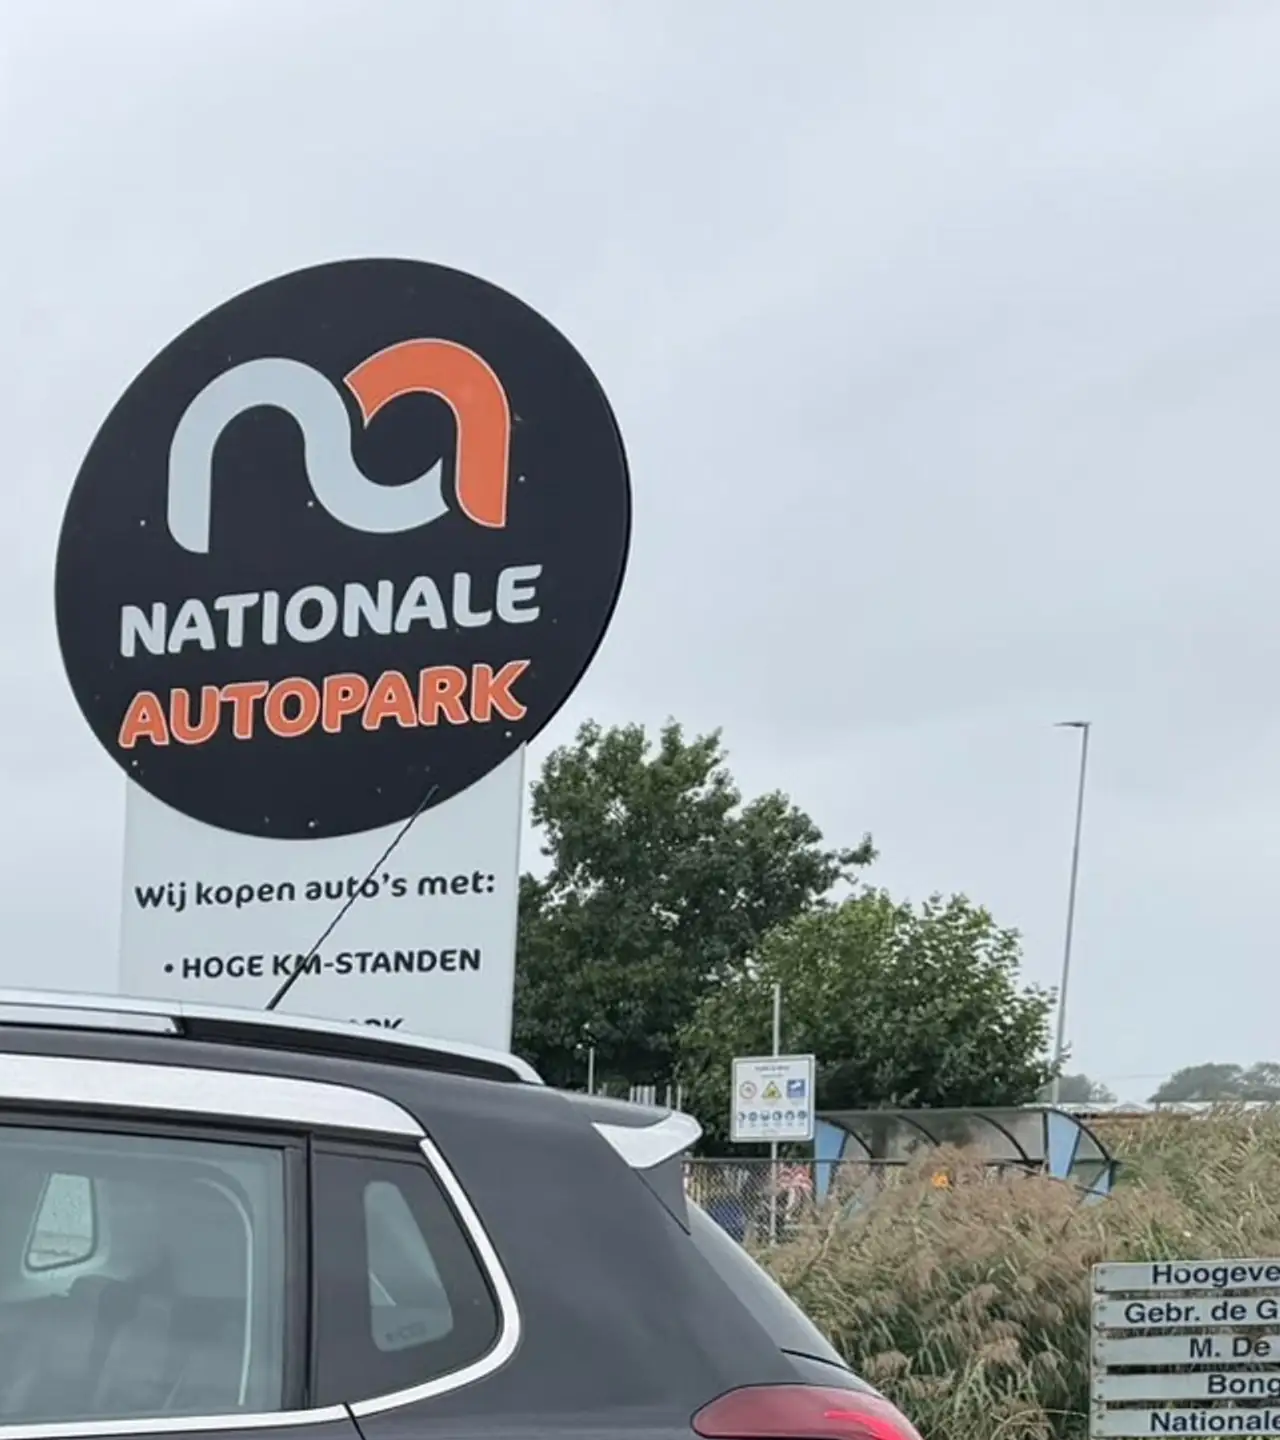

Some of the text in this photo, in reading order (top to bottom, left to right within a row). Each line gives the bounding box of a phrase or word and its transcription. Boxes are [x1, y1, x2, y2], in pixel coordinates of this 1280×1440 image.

[120, 565, 542, 658] NATIONALE
[118, 659, 531, 749] AUTOPARK
[135, 870, 495, 912] Wij kopen auto's met:
[182, 948, 481, 979] HOGE KM-STANDEN
[1152, 1263, 1280, 1288] Hoogeve
[1124, 1302, 1201, 1324] Gebr.
[1211, 1301, 1247, 1321] de
[1190, 1337, 1271, 1358] M. De
[1208, 1374, 1280, 1399] Bong
